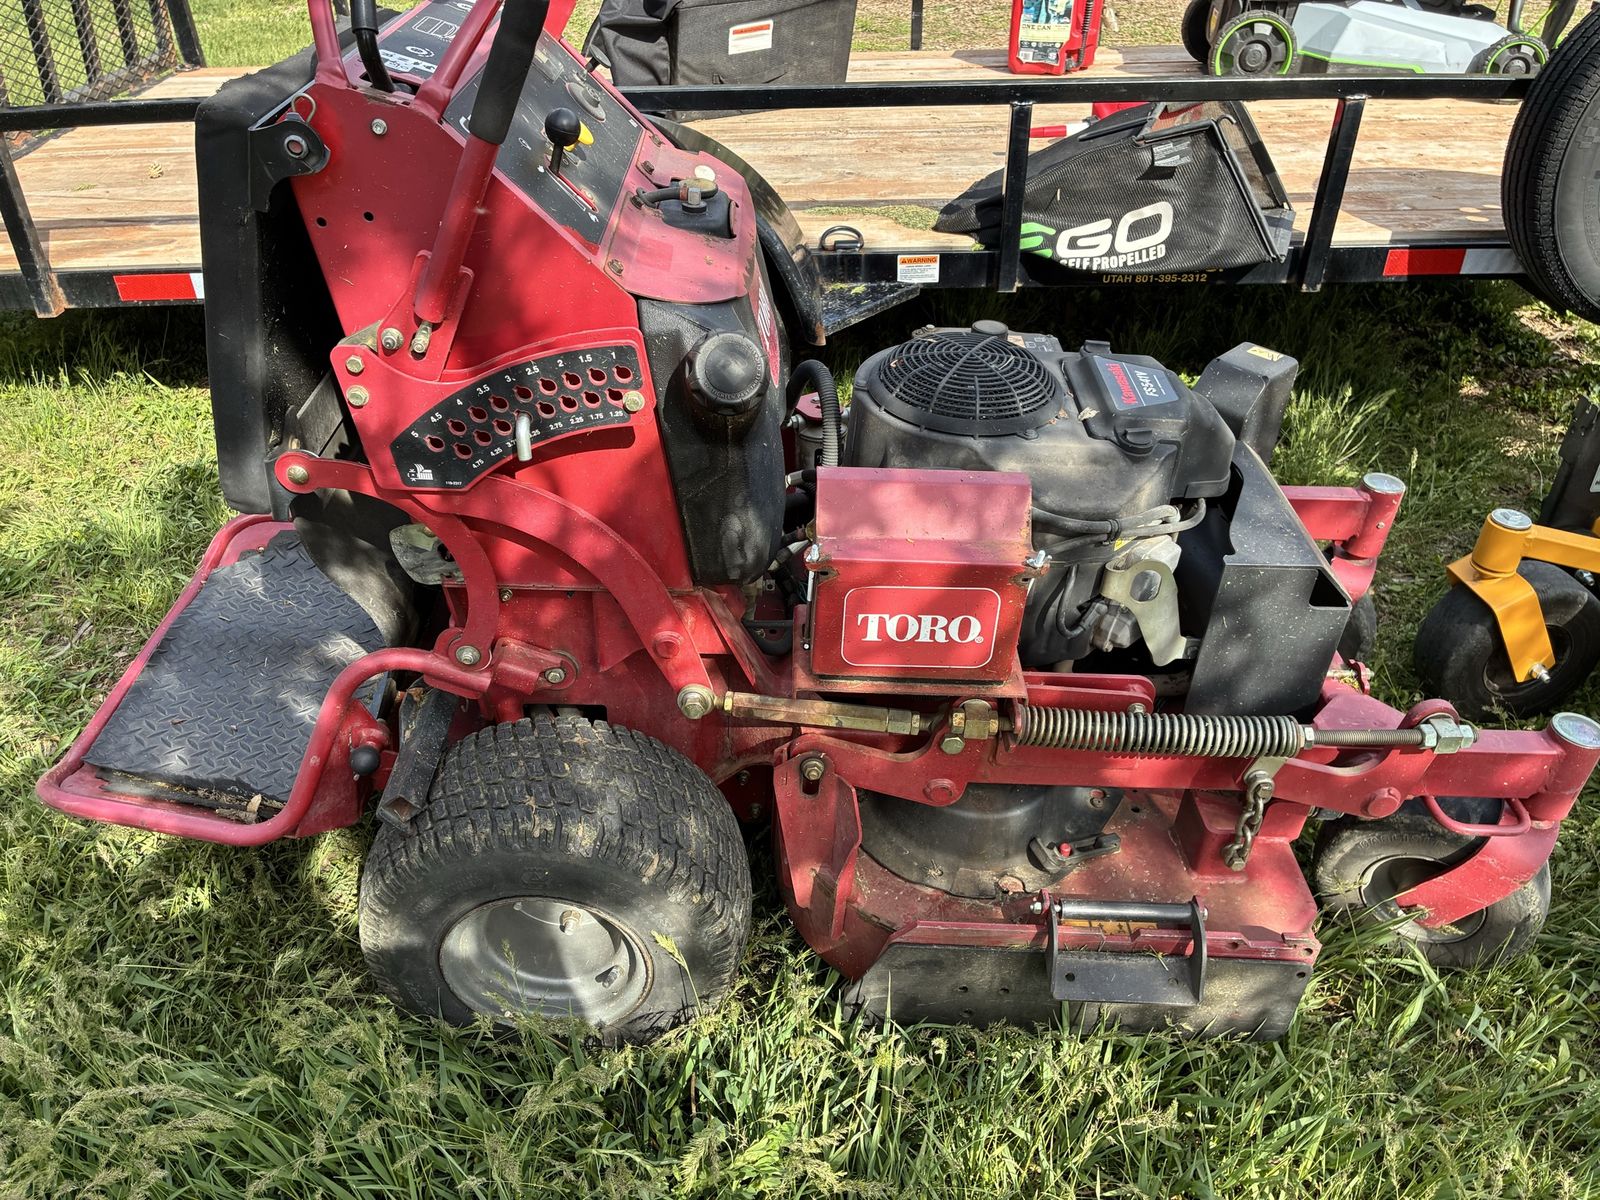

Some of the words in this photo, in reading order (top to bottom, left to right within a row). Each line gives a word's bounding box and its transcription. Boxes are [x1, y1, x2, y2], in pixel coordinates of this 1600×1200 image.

[1021, 201, 1174, 258] EGO
[1092, 244, 1166, 270] PROPELLED
[1102, 274, 1132, 284] UTAH
[1135, 274, 1208, 282] 801-395-2312
[430, 412, 442, 423] 4.5
[476, 384, 490, 395] 3.5
[526, 366, 539, 375] 2.5
[579, 354, 592, 363] 1.5
[1105, 363, 1138, 404] Kawasaki
[1134, 370, 1160, 397] FS541V
[472, 459, 484, 469] 4.75
[490, 447, 503, 457] 4.25
[549, 422, 563, 430] 2.75
[857, 613, 982, 643] TORO
